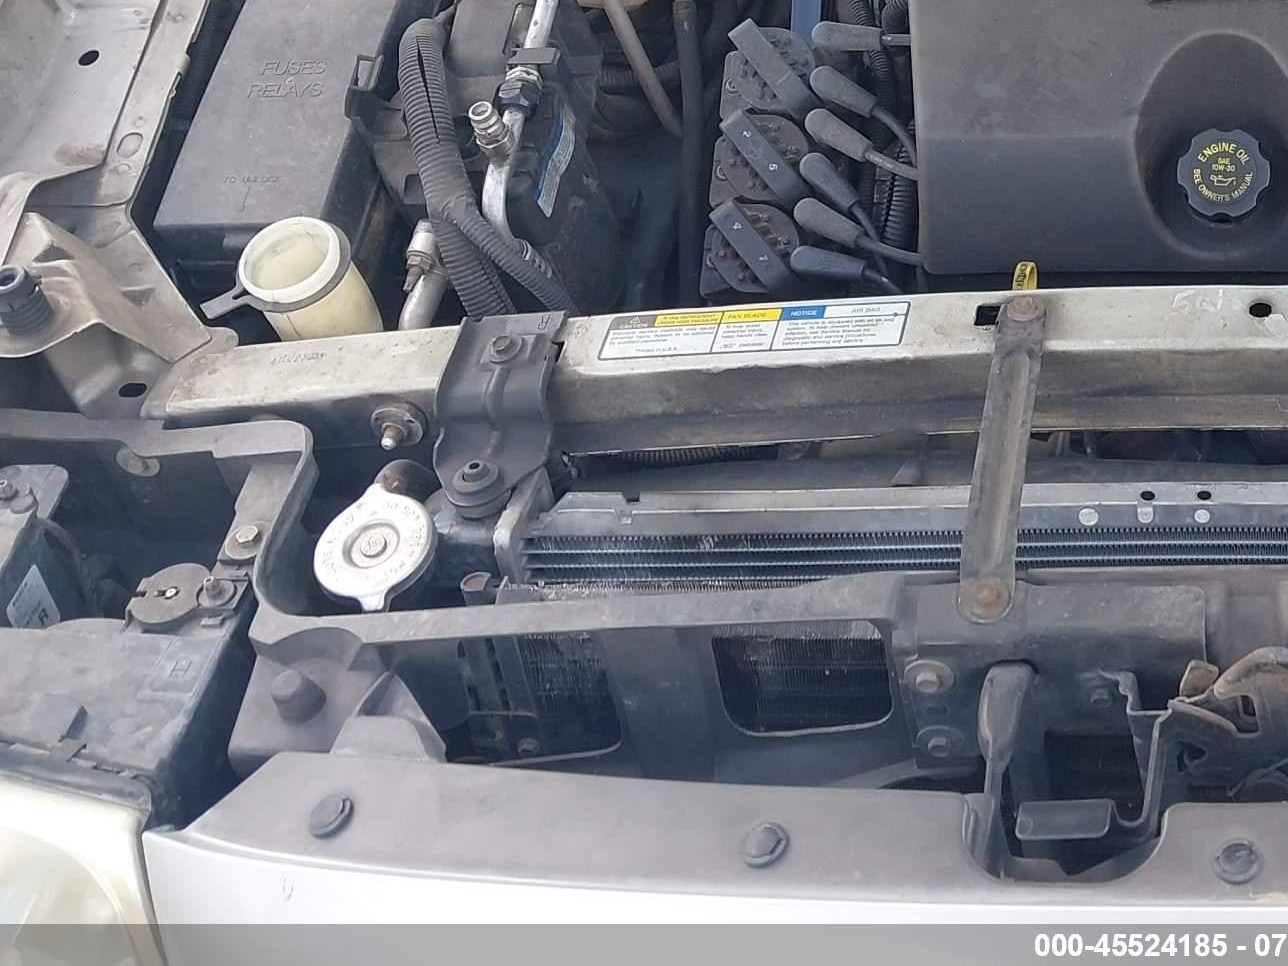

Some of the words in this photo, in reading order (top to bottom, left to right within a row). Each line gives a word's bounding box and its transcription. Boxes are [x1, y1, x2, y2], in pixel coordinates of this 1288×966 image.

[260, 58, 328, 76] FUSES
[247, 83, 324, 98] RELAYS
[1197, 142, 1237, 163] ENGINE
[1236, 149, 1250, 166] OIL
[1217, 157, 1231, 165] SAE
[1211, 163, 1236, 172] 10W-30
[223, 176, 236, 184] TO
[243, 176, 281, 184] UNLOCK
[1193, 168, 1203, 185] SEE
[1198, 184, 1231, 202] OWNER'S
[1231, 171, 1253, 199] MANUAL
